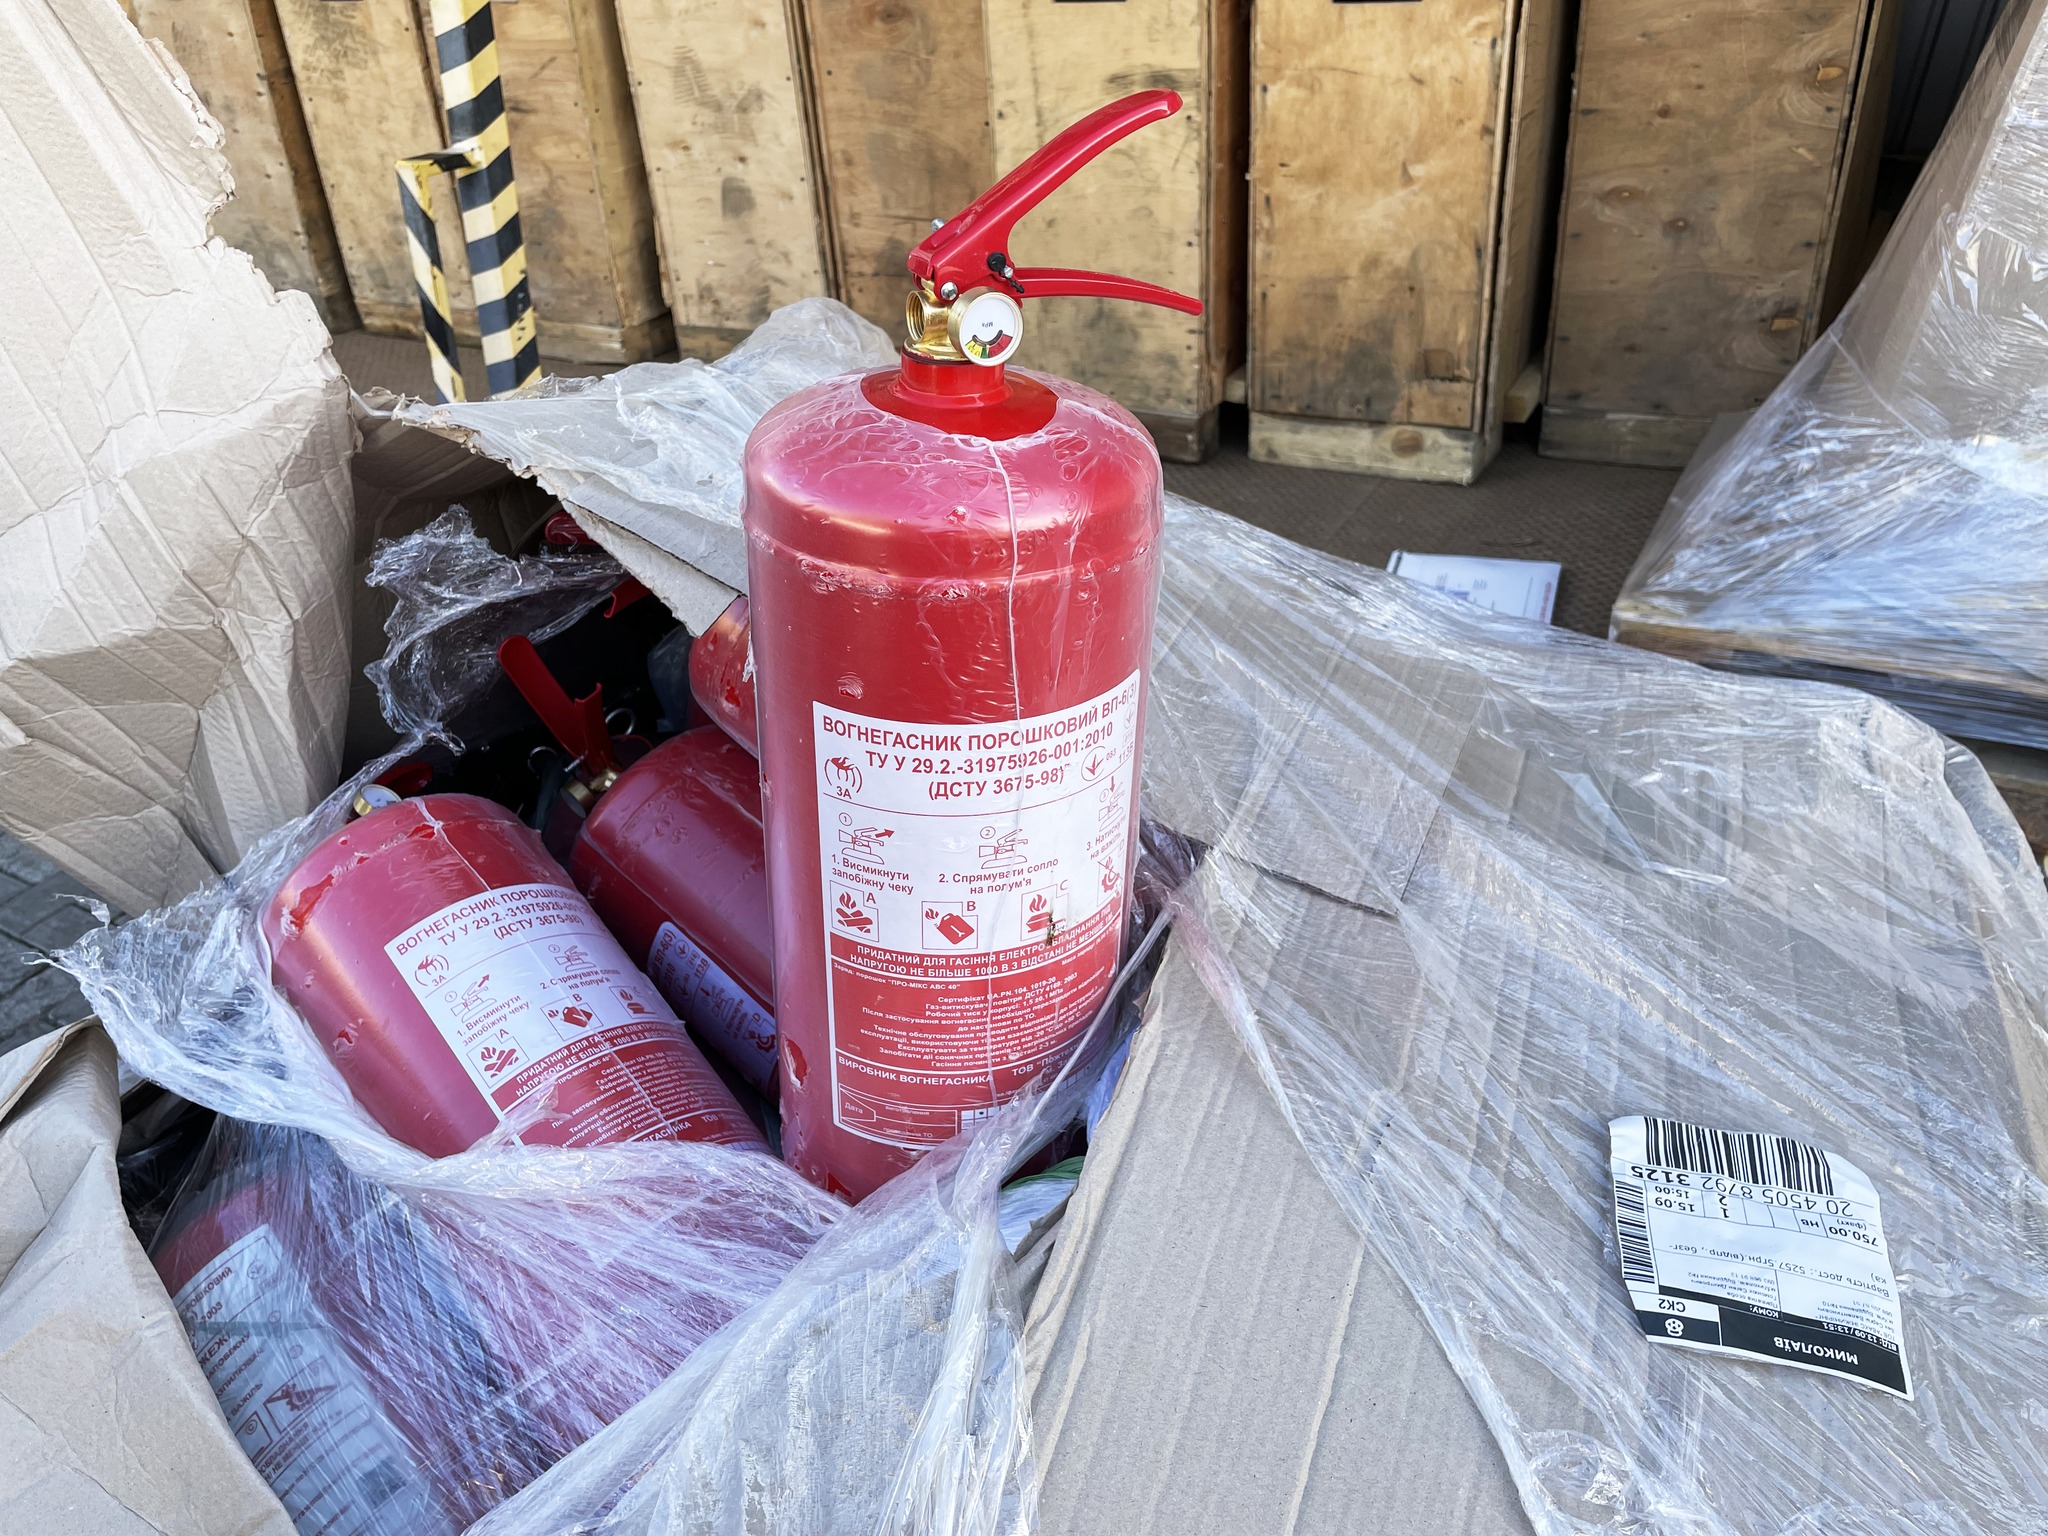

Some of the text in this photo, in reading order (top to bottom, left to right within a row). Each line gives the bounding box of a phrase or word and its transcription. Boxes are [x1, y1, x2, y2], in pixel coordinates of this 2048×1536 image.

[823, 680, 1136, 751] ВОГНЕГАСНИК ПОРОШКОВИЙ ВП-6(3)
[865, 722, 1113, 774] ТУ У 29.2.-31975926-001:2010
[929, 781, 987, 800] (ДСТУ
[831, 854, 910, 881] 1. Висмикнути
[938, 858, 1059, 884] 2. Спрямувати сопло
[832, 867, 914, 895] запобіжну чеку
[970, 886, 984, 895] на
[1059, 879, 1068, 891] C
[866, 893, 876, 904] A
[966, 901, 976, 912] B
[396, 896, 501, 956] ВОГНЕГАСНИК
[438, 930, 457, 946] ТУ
[458, 923, 469, 936] У
[493, 919, 534, 940] (ДСТУ
[654, 929, 677, 967] ВП-6(3)
[857, 945, 920, 965] ПРИДАТНИЙ
[923, 957, 946, 966] ДЛЯ
[950, 955, 996, 966] ГАСІННЯ
[850, 954, 907, 975] НАПРУГОЮ
[910, 967, 924, 976] НЕ
[928, 968, 971, 977] БІЛЬШЕ
[975, 965, 998, 976] 1000
[1001, 963, 1009, 972] В
[1021, 946, 1064, 967] ВІДСТАНІ
[1066, 941, 1077, 952] НЕ
[540, 980, 550, 991] 2.
[567, 982, 580, 990] на
[856, 971, 887, 984] порошок
[572, 993, 583, 1002] B
[938, 995, 985, 1004] Сертифікат
[1025, 988, 1045, 1000] ДСТУ
[456, 994, 521, 1038] 1. Висмикнути
[862, 1006, 883, 1017] Після
[885, 1013, 939, 1025] застосування
[992, 1008, 1031, 1021] необхідно
[926, 1010, 961, 1018] Робочий
[462, 1001, 530, 1047] запобіжну чеку
[499, 1028, 510, 1039] A
[873, 1024, 907, 1037] Технічне
[909, 1031, 975, 1040] обслуговування
[860, 1029, 909, 1044] експлуатації,
[911, 1039, 979, 1047] використовуючи
[879, 1047, 921, 1059] Запобігати
[897, 1044, 957, 1053] Експлуатувати
[515, 1047, 569, 1084] ПРИДАТНИЙ
[570, 1038, 589, 1053] ДЛЯ
[838, 1055, 1034, 1086] ВИРОБНИК ВОГНЕГАСНИКА ТОВ
[515, 1061, 565, 1098] НАПРУГОЮ
[564, 1054, 579, 1066] НЕ
[571, 1089, 616, 1116] застосування
[844, 1102, 864, 1115] Дата
[568, 1113, 599, 1134] Технічне
[597, 1105, 646, 1133] Експлуатувати
[1631, 1165, 1854, 1218] 20 4505 8792 3125
[1654, 1185, 1690, 1199] 15:00
[1718, 1193, 1728, 1206] 2
[1654, 1196, 1696, 1213] 15.09
[1720, 1207, 1730, 1219] 1
[1836, 1218, 1867, 1231] (факт)
[1829, 1226, 1880, 1247] 750.00
[1846, 1278, 1890, 1298] Вартість
[1870, 1272, 1887, 1285] ка)
[1749, 1304, 1779, 1319] КОМУ:
[1822, 1322, 1897, 1352] ВІД: 13.09 13:51
[1773, 1336, 1859, 1366] МИКОЛАЇВ
